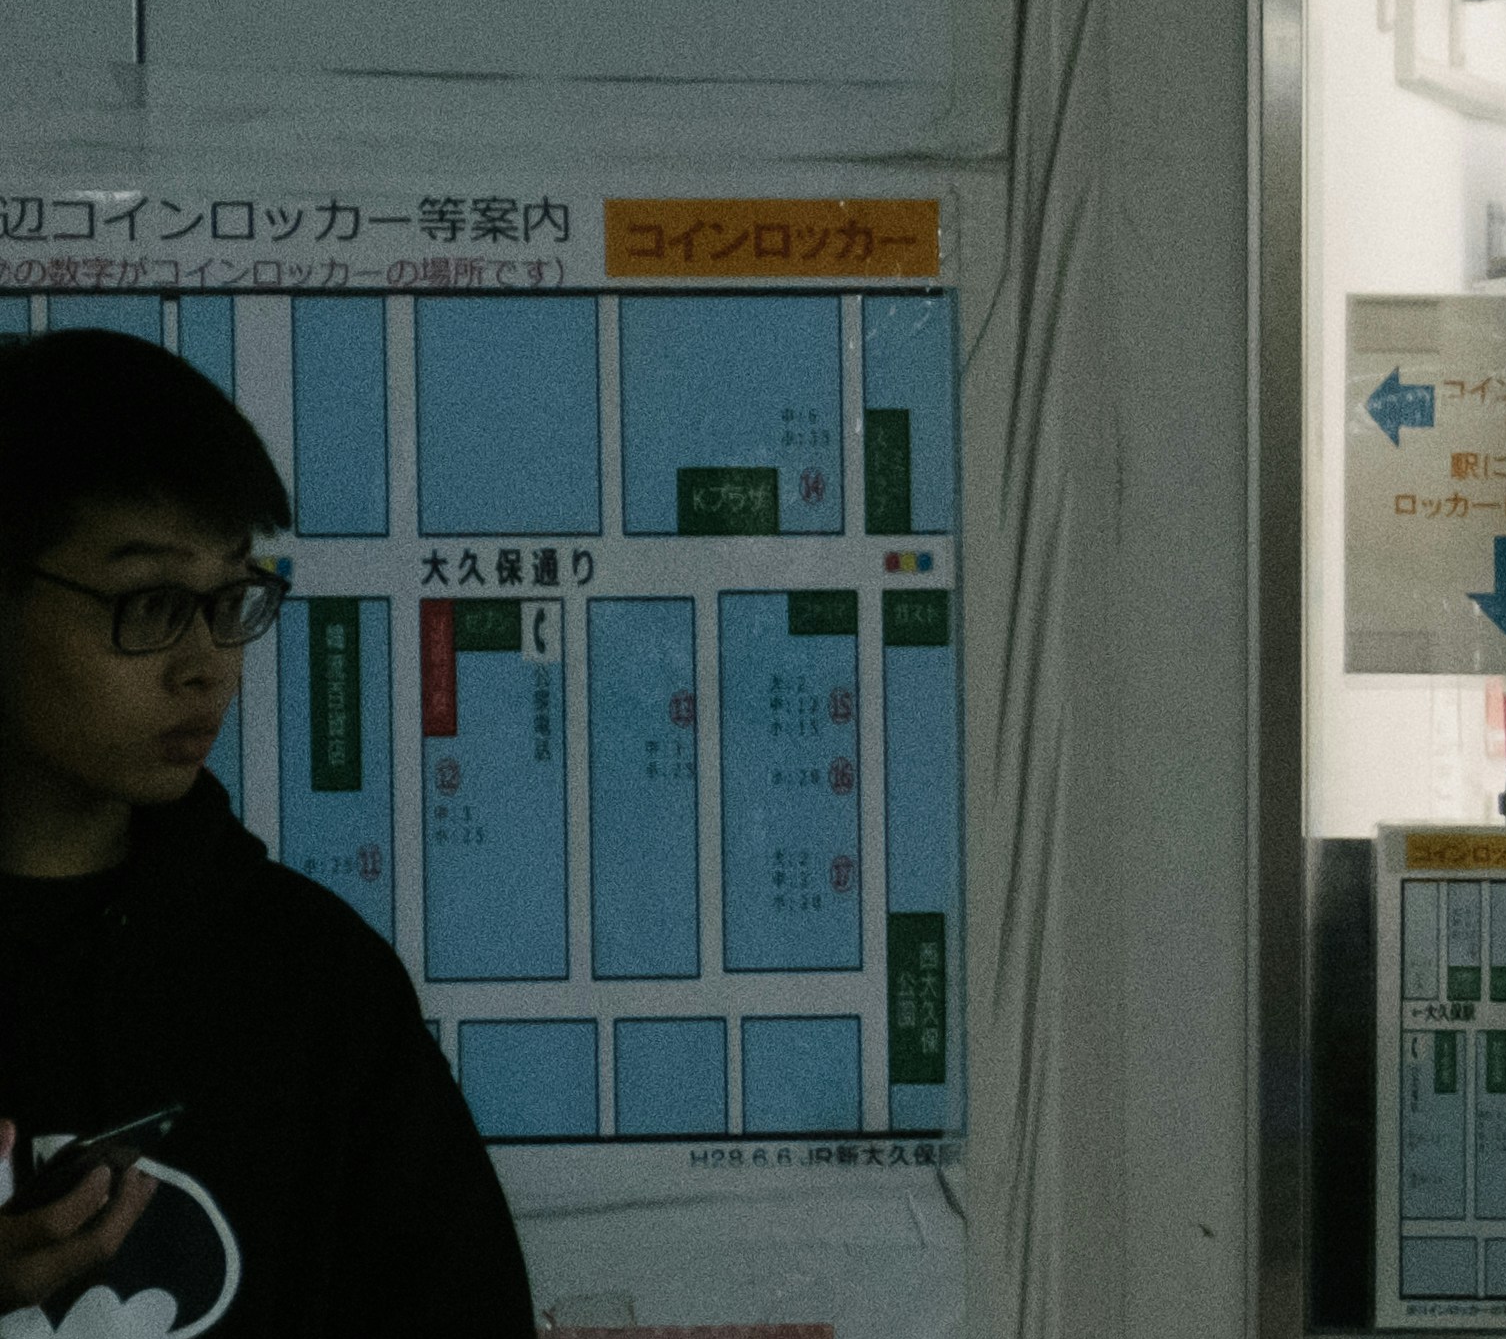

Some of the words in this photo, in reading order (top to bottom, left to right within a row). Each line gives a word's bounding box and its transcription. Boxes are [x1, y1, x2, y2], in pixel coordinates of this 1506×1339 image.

[626, 217, 918, 265] コインロッカー
[421, 549, 597, 586] 大久保通り
